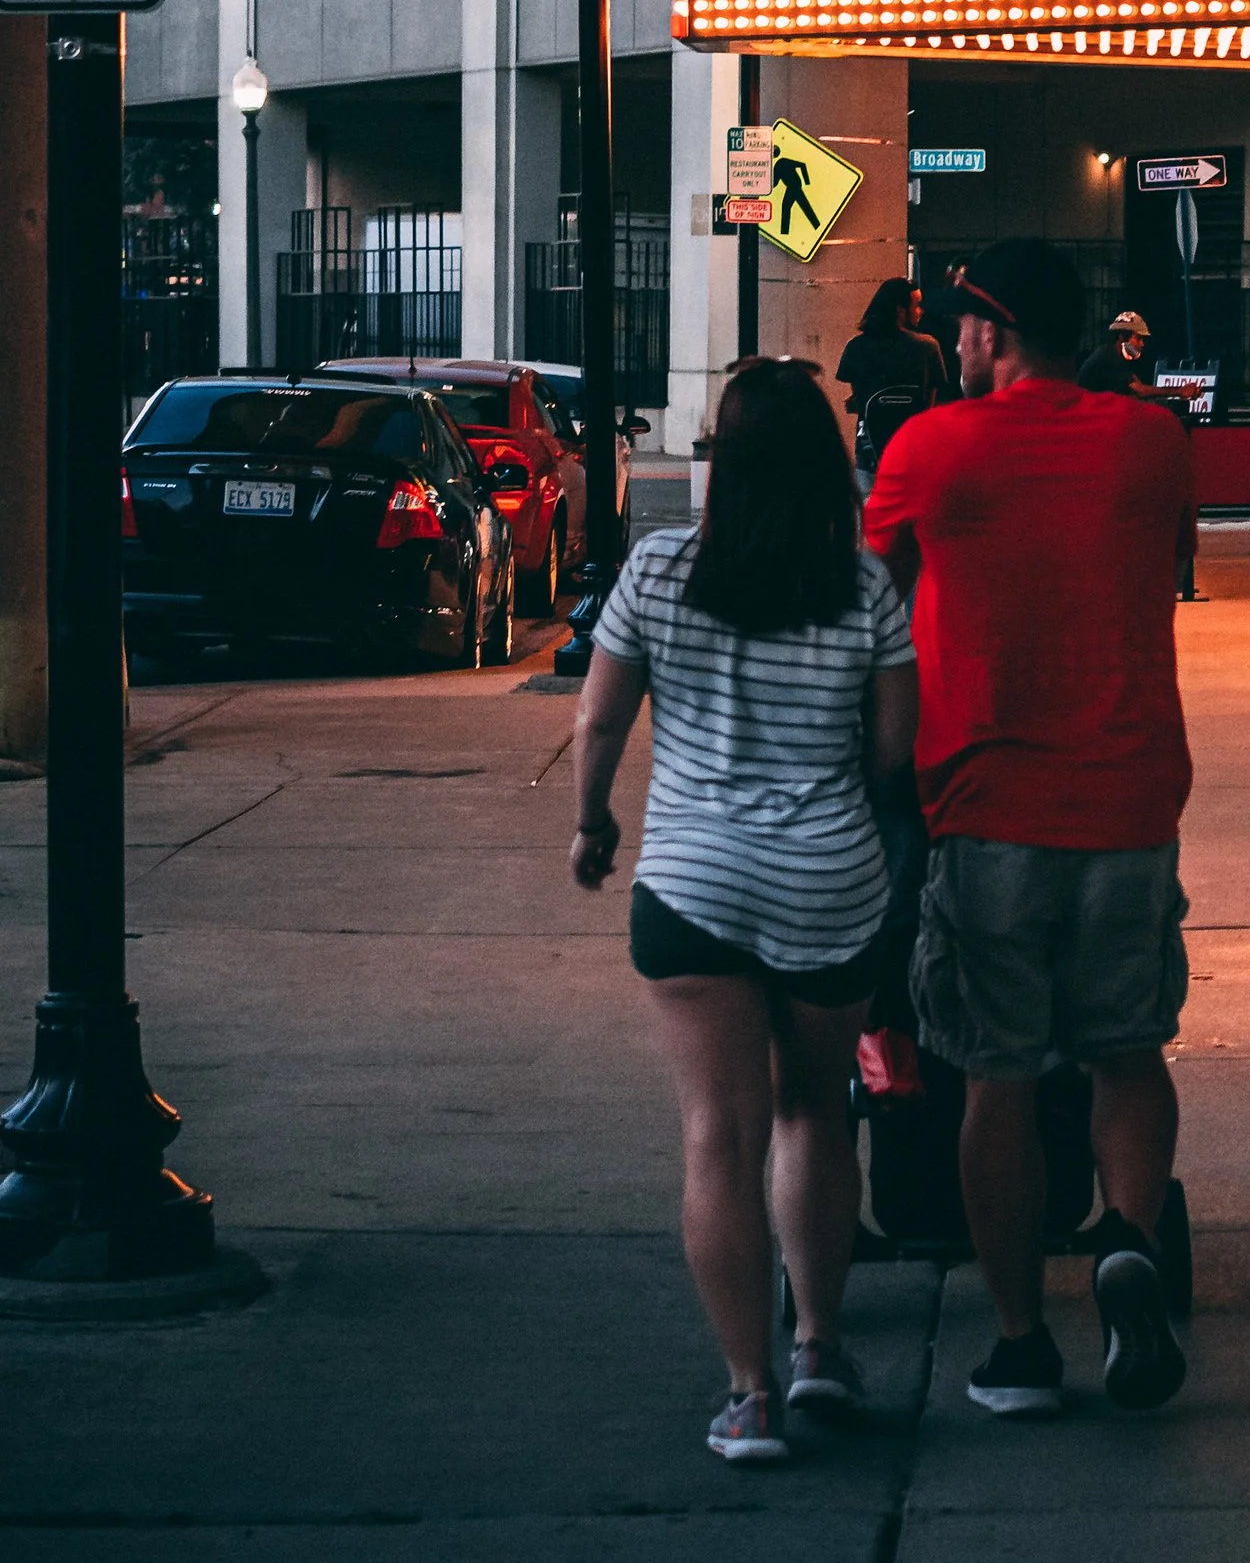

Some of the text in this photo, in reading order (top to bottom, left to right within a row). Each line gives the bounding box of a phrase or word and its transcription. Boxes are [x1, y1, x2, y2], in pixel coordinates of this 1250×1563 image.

[731, 139, 744, 149] 10
[730, 160, 769, 168] RESTAURANT
[913, 151, 981, 171] Broadway
[732, 170, 767, 178] CARRYOUT
[1148, 166, 1199, 181] ONE WAY
[732, 203, 768, 211] THIS SIDE
[260, 490, 291, 509] 5179
